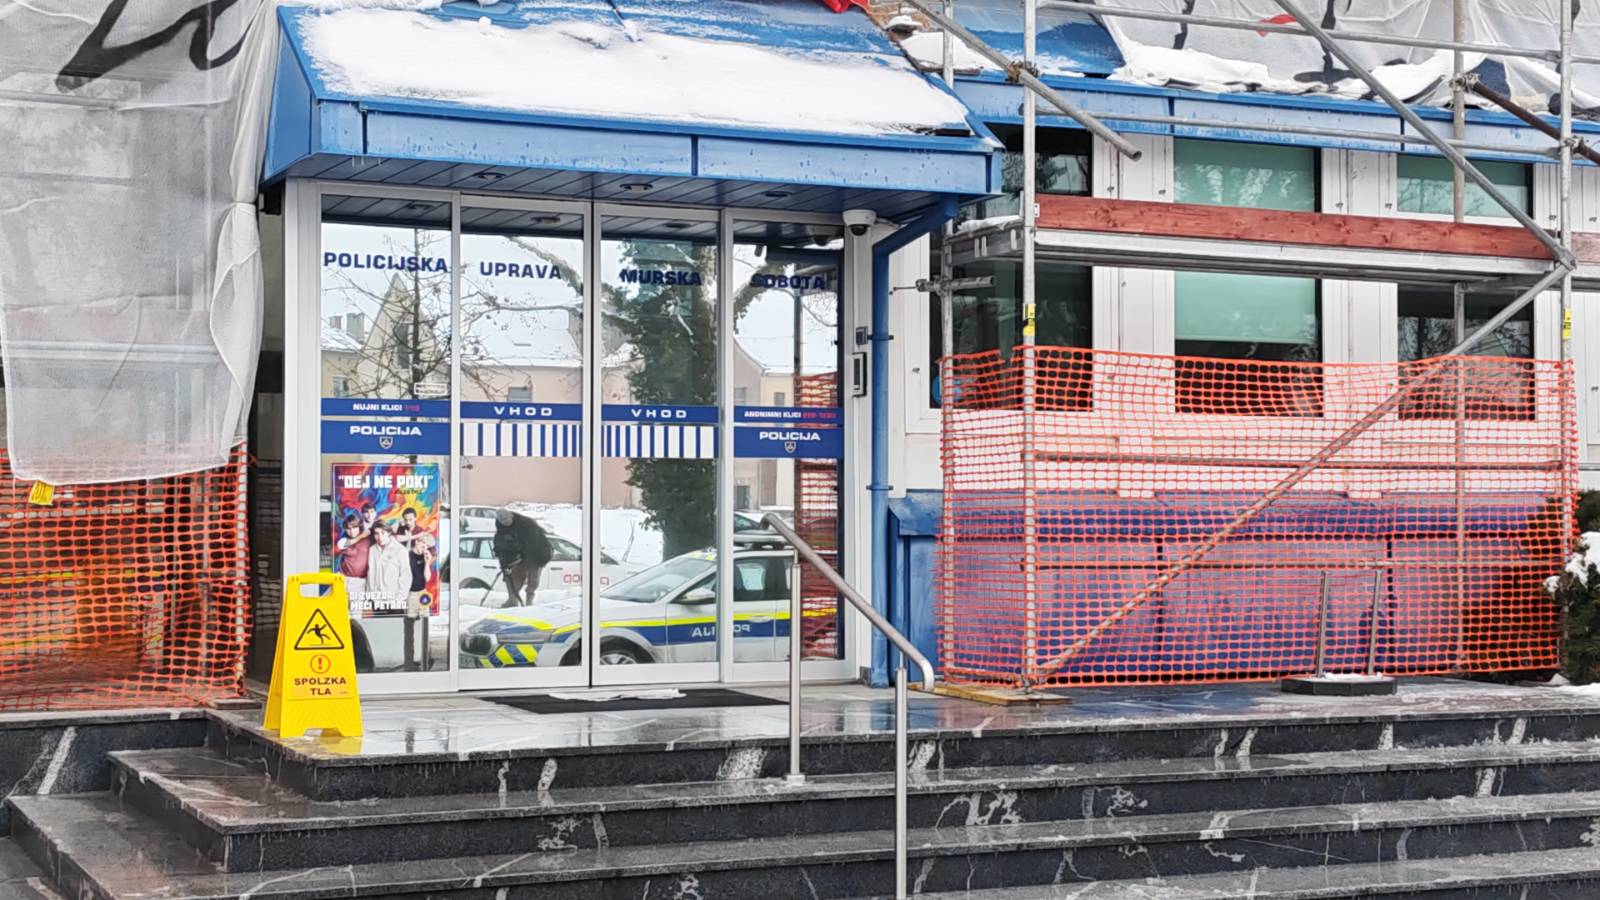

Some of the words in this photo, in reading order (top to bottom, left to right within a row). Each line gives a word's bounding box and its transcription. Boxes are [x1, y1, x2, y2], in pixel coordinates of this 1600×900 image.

[323, 252, 448, 273] POLICIJSKA
[480, 261, 562, 279] UPRAVA
[620, 269, 702, 286] MURSKA
[750, 273, 826, 290] SOBOTA
[494, 405, 553, 417] VHOD
[631, 409, 687, 419] VHOD
[350, 425, 422, 437] POLICIJA
[759, 431, 821, 441] POLICIJA
[374, 475, 393, 489] NE
[294, 677, 347, 686] SPOLZKA
[310, 687, 332, 696] TLA
